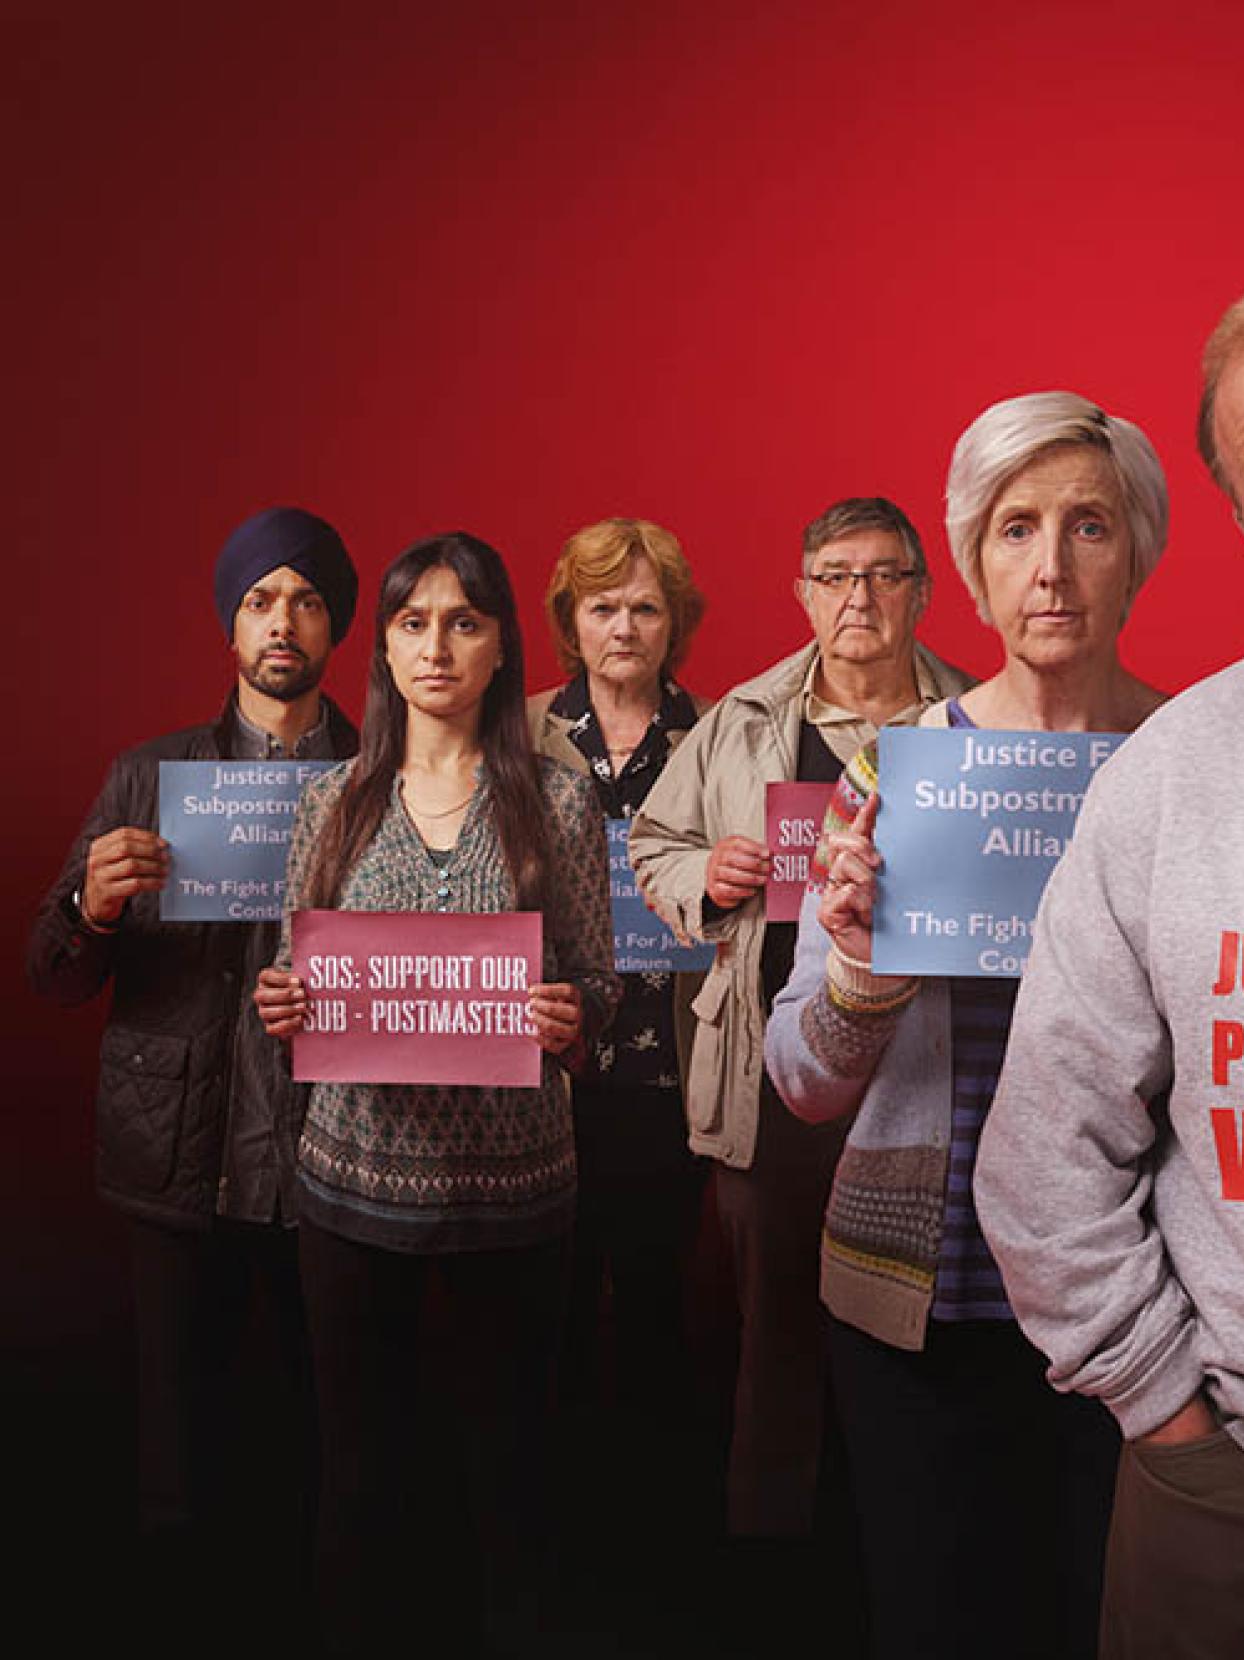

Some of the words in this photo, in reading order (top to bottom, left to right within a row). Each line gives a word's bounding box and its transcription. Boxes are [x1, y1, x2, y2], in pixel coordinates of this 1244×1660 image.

[960, 736, 1077, 772] Justice
[213, 766, 288, 790] Justice
[179, 880, 216, 897] The
[221, 880, 267, 899] Fight
[904, 911, 959, 937] The
[309, 955, 361, 990] SOS:
[368, 955, 474, 989] SUPPORT
[481, 957, 528, 990] OUR
[371, 1000, 538, 1035] POSTMASTERS
